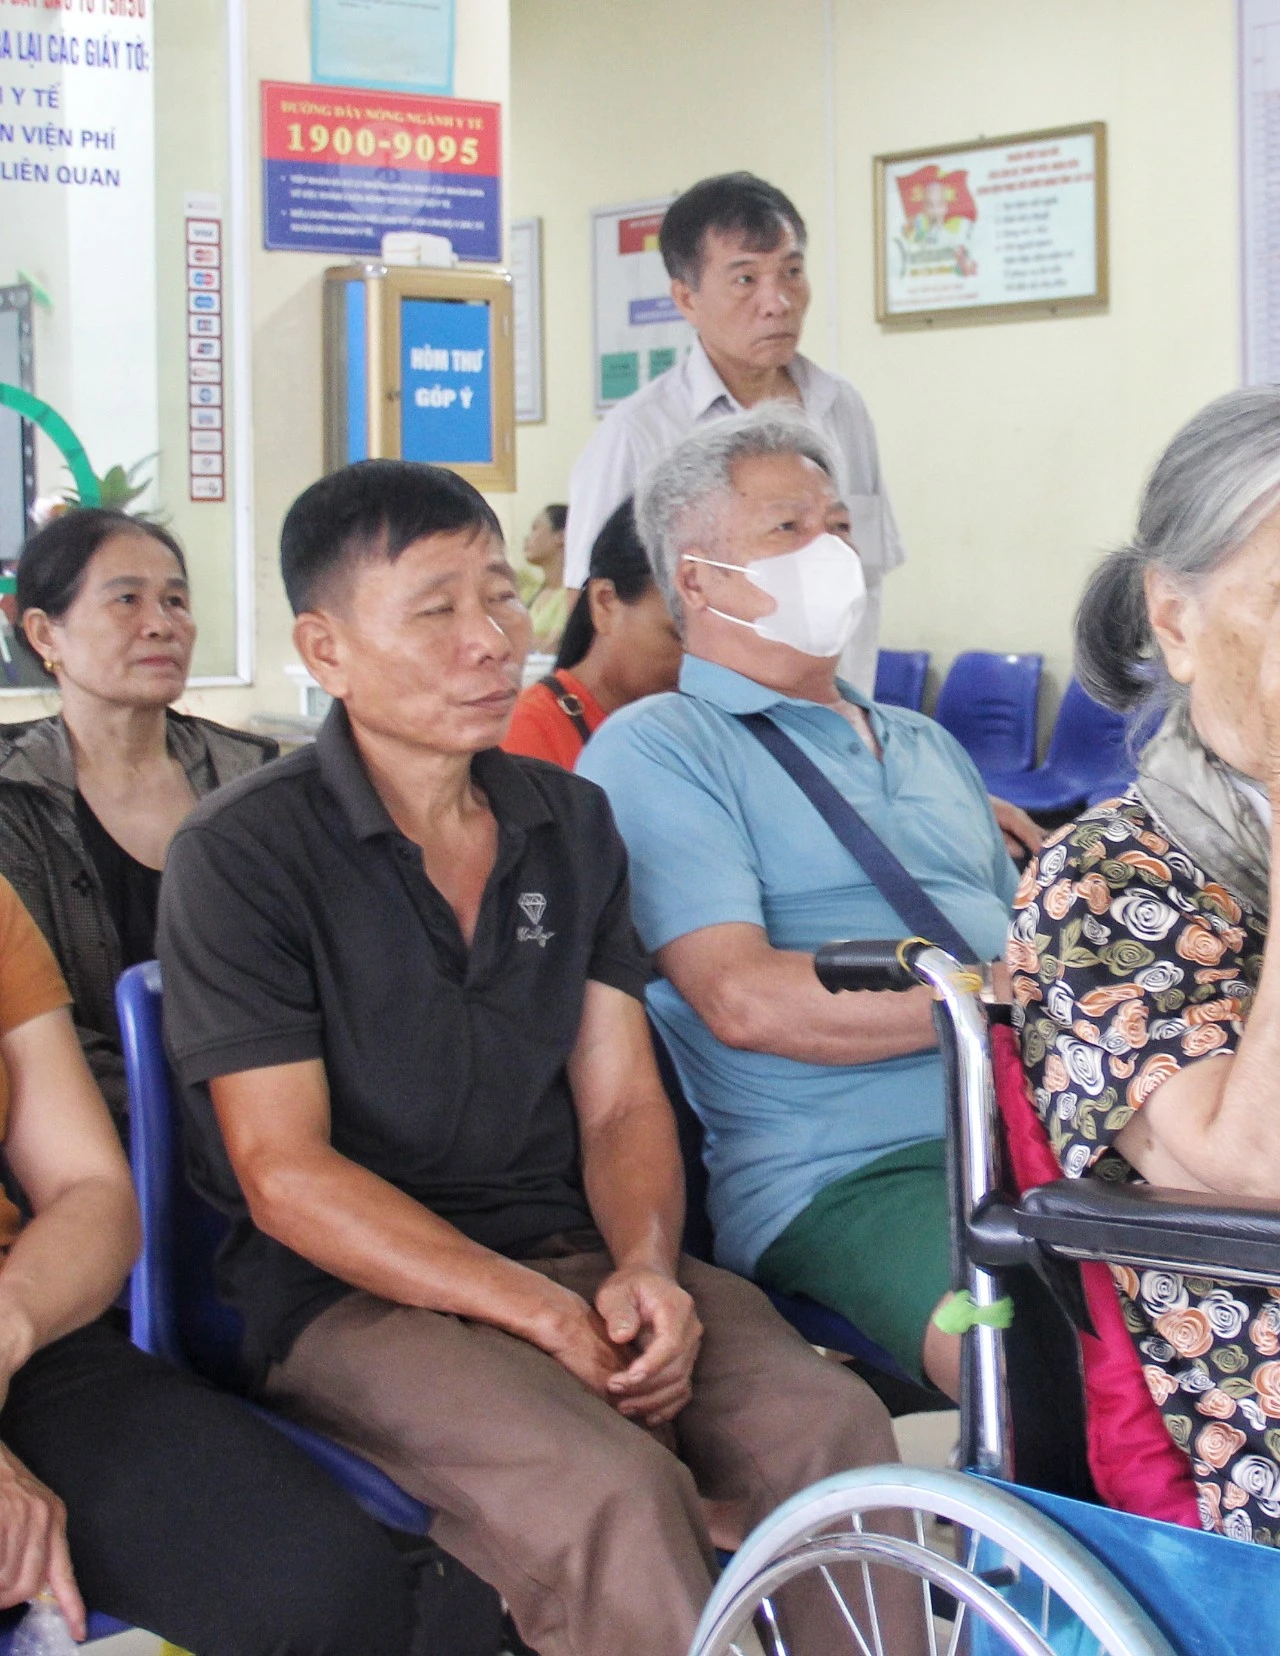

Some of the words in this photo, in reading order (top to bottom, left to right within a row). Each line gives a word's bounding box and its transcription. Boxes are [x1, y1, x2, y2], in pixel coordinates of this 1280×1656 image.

[16, 31, 42, 69] LẠI
[48, 29, 79, 66] CÁC
[85, 30, 120, 69] GIẤY
[11, 86, 26, 107] Y
[33, 81, 61, 109] TẾ
[22, 121, 73, 152] VIỆN
[81, 126, 116, 150] PHÍ
[286, 122, 480, 166] 1900-9095
[1, 157, 49, 183] LIÊN
[56, 165, 121, 187] QUAN
[452, 348, 485, 374] THƯ
[415, 383, 457, 409] GÓP
